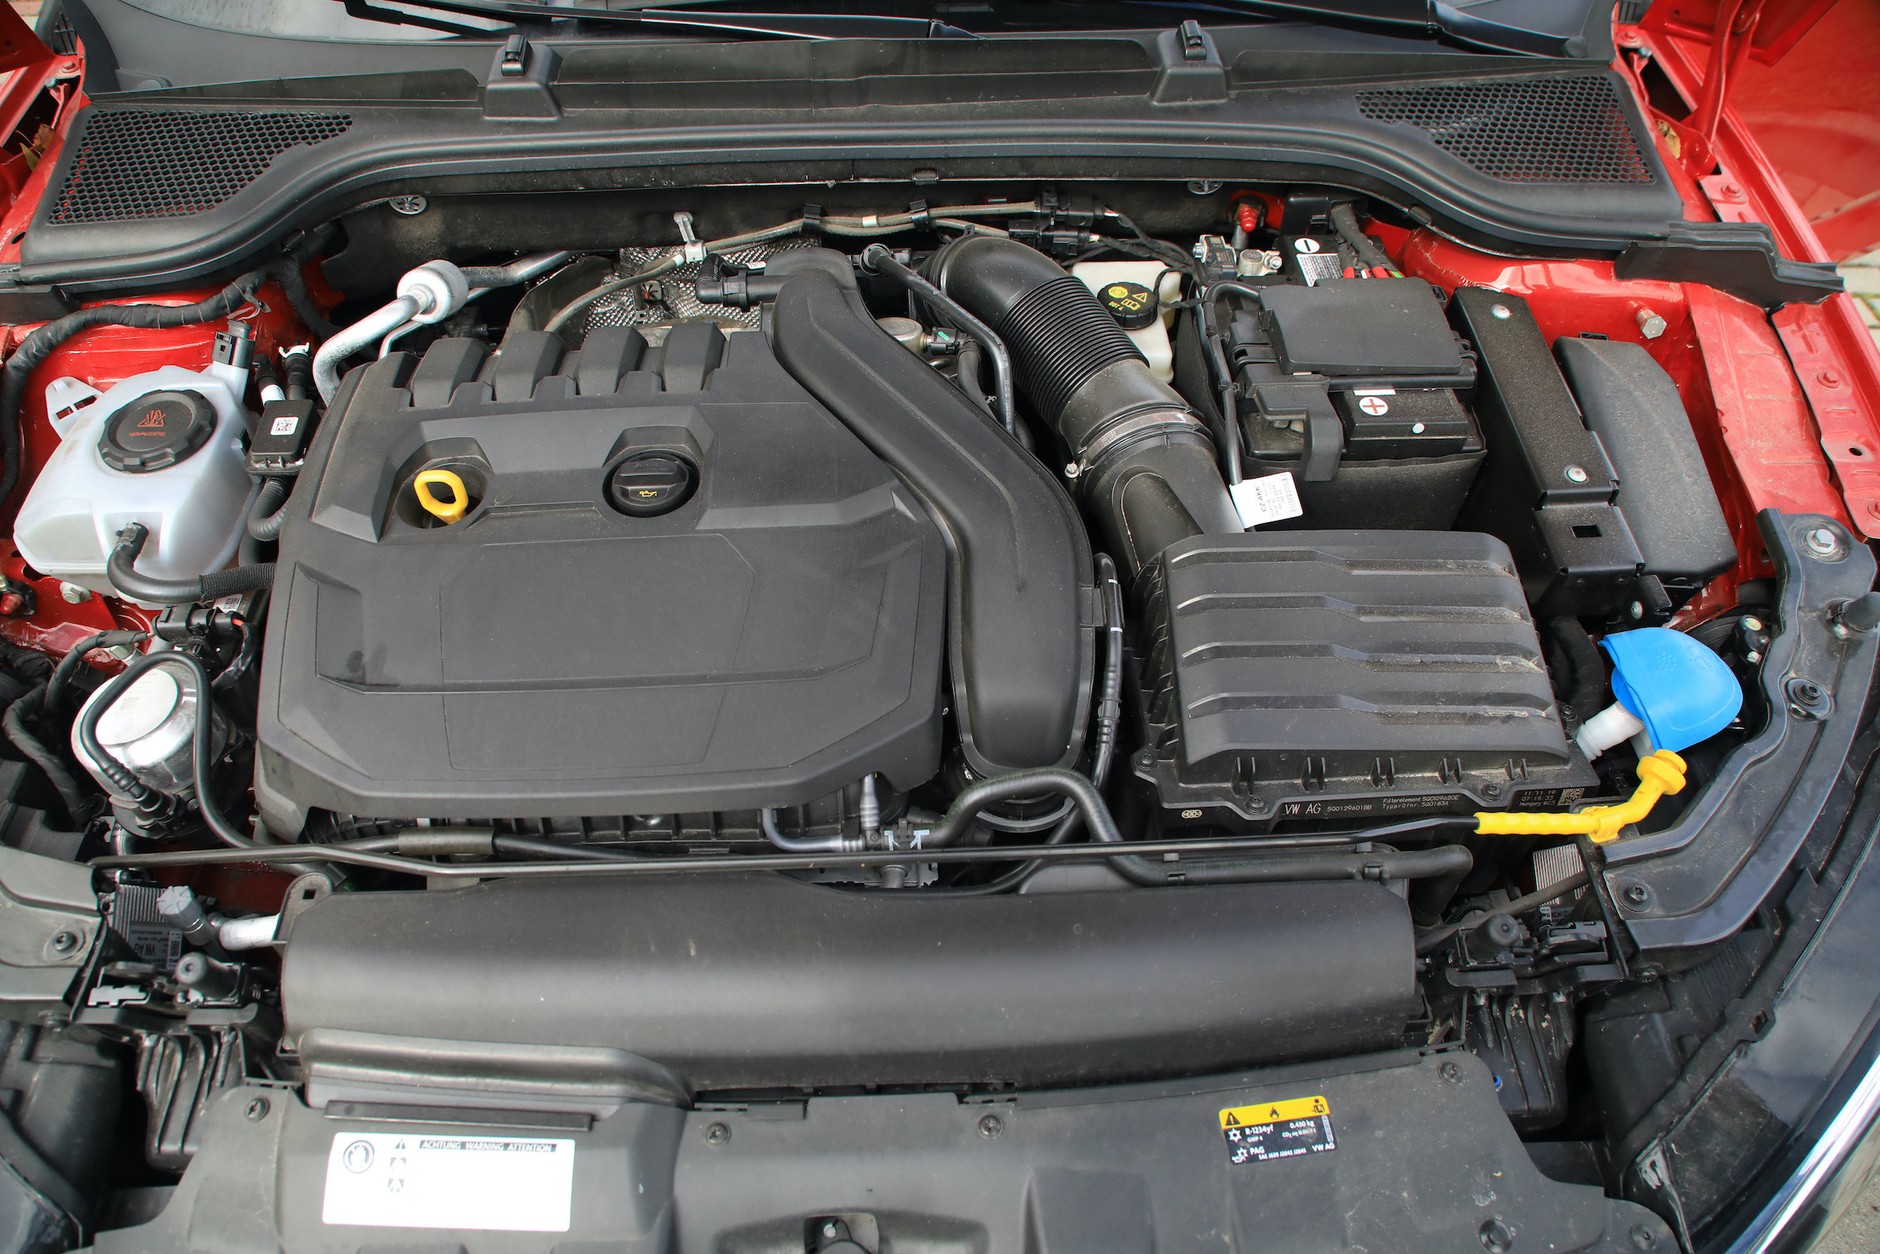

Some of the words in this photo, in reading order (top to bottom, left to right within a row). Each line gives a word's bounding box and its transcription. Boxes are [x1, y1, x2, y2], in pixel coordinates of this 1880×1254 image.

[1285, 804, 1299, 814] VW
[1306, 803, 1322, 814] AG
[1245, 1124, 1274, 1135] R-1234yf
[422, 1140, 461, 1150] ACHTUNG
[465, 1141, 504, 1151] WARNING
[507, 1142, 551, 1153] ATTENTION
[1250, 1146, 1265, 1155] PAG
[1312, 1144, 1325, 1152] VW
[1325, 1142, 1335, 1150] AG
